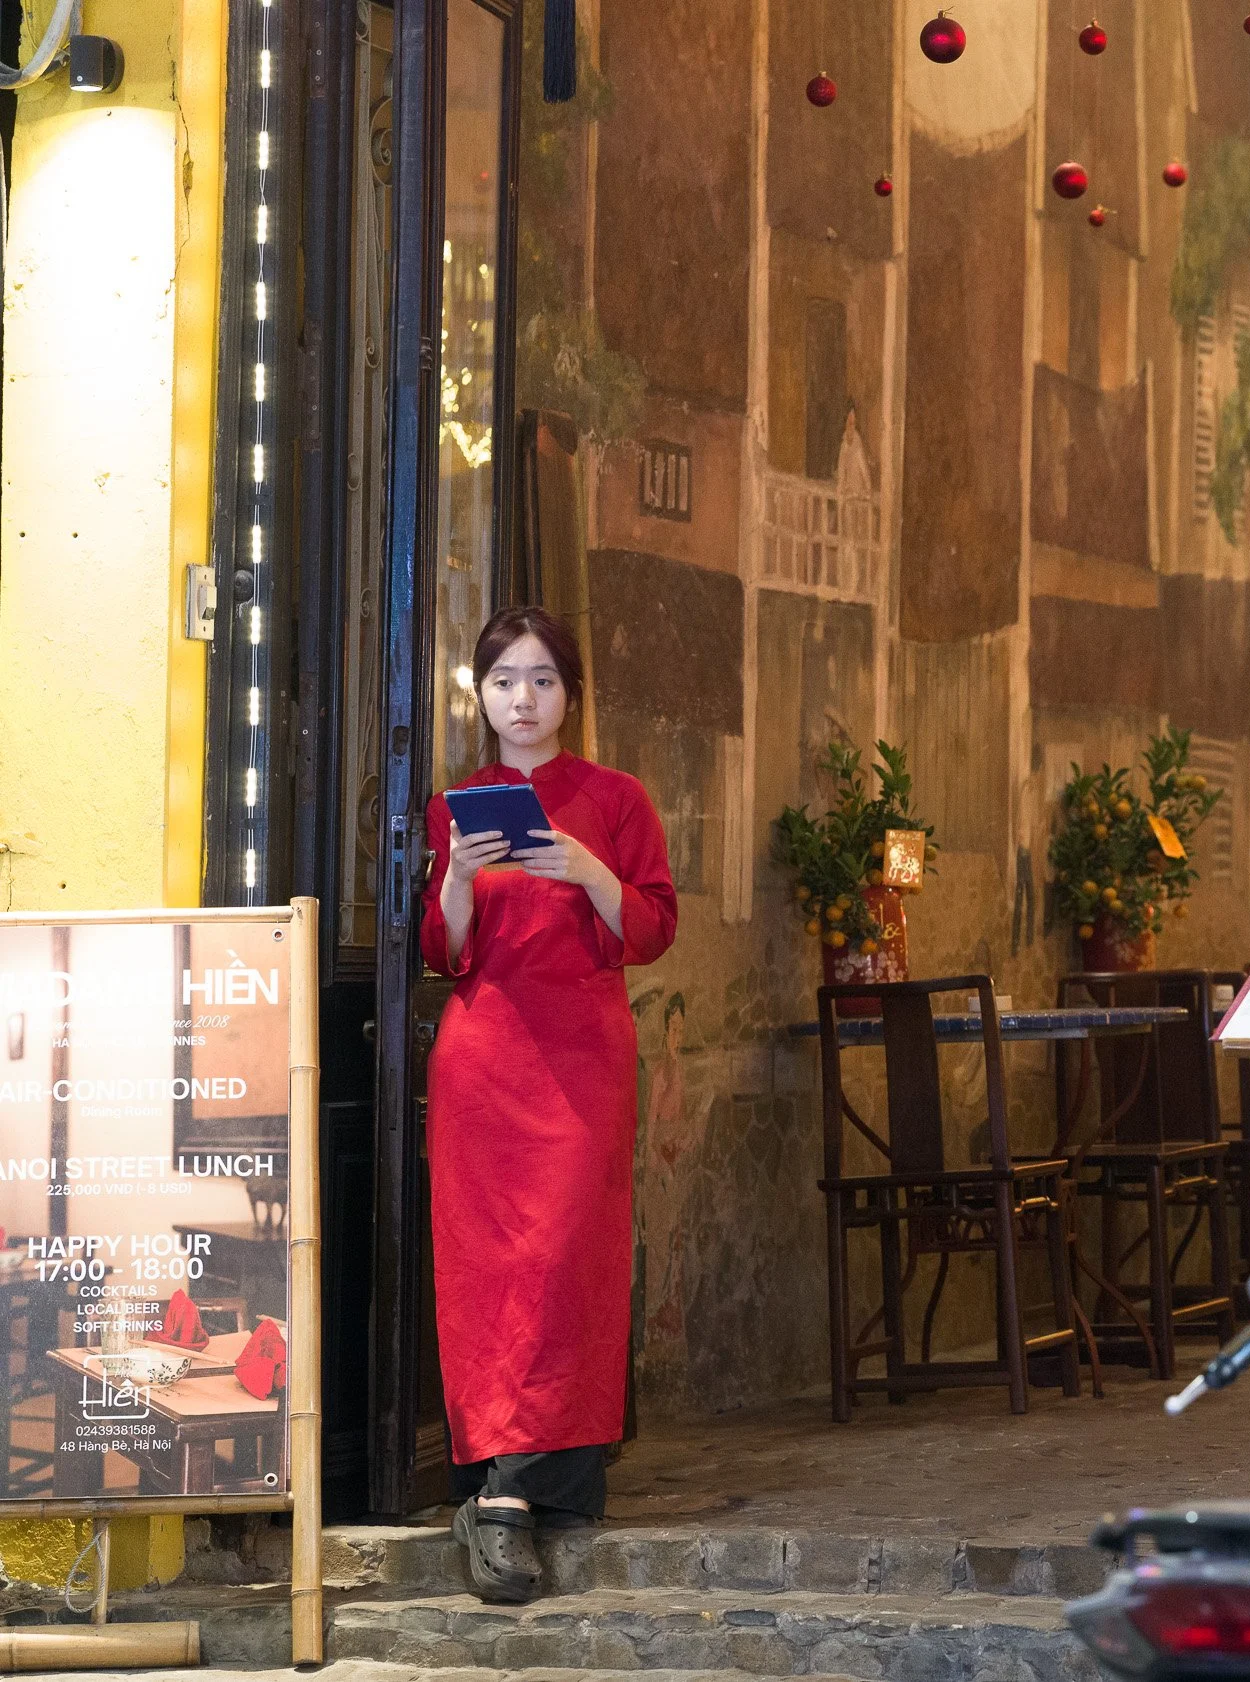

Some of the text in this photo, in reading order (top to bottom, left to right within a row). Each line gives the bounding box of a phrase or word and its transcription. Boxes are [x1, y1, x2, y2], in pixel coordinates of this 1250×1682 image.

[182, 948, 279, 1005] HIỀN
[192, 1013, 231, 1028] 2008
[0, 1077, 247, 1103] AIR-CONDITIONED
[65, 1156, 171, 1180] STREET
[178, 1154, 273, 1178] LUNCH
[46, 1183, 101, 1197] 225,000
[104, 1183, 133, 1195] VND
[28, 1233, 212, 1259] HAPPY HOUR
[34, 1258, 106, 1282] 17:00
[131, 1256, 204, 1280] 18:00
[80, 1284, 158, 1297] COCKTAILS
[77, 1302, 160, 1316] LOCAL BEER
[73, 1319, 163, 1333] SOFT DRINKS
[75, 1424, 156, 1437] 02439381588
[60, 1439, 172, 1453] 48 Hàng Bè, Hà Nội
